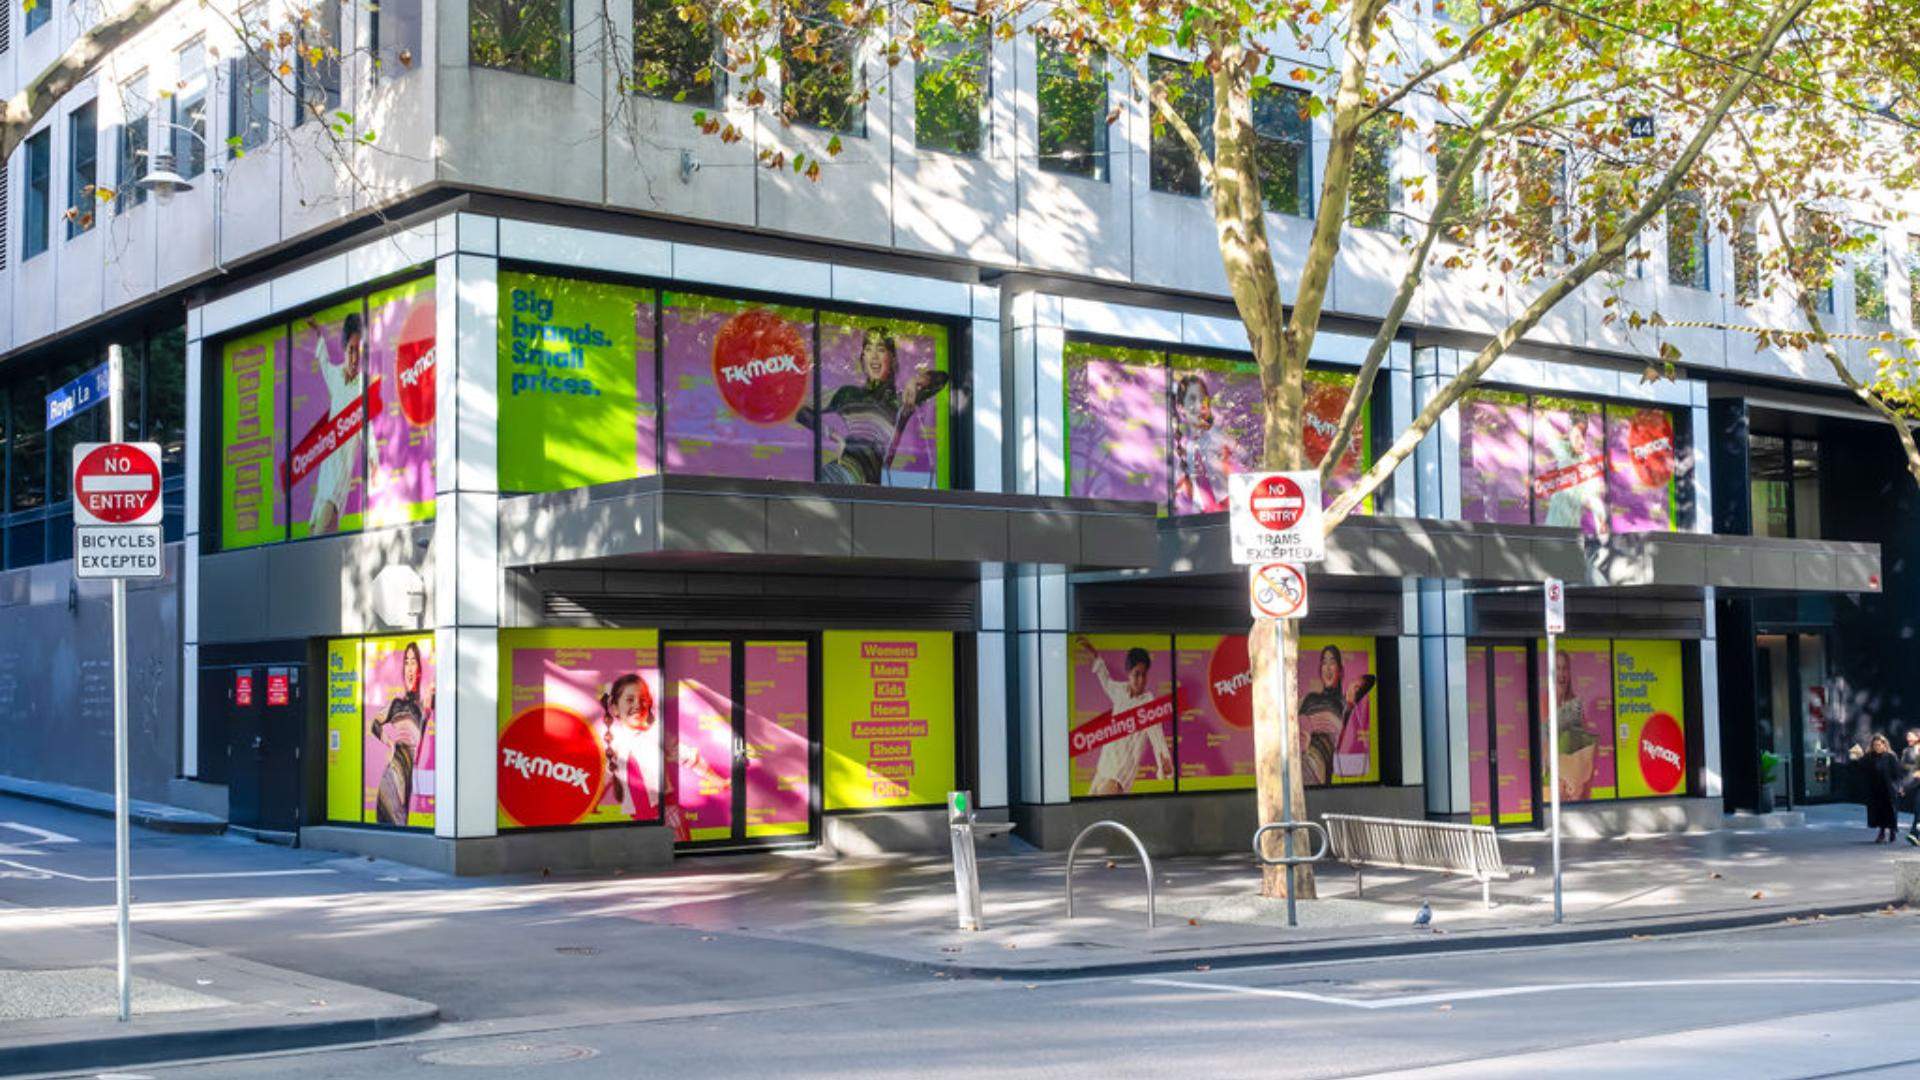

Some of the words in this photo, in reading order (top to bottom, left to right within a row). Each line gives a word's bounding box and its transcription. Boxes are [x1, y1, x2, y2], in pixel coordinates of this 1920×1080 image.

[1632, 121, 1652, 136] 44
[511, 290, 554, 321] Big
[511, 316, 612, 347] brands.
[511, 340, 585, 369] Small
[511, 369, 601, 396] prices.
[78, 385, 91, 404] La
[291, 429, 336, 474] Opening
[104, 457, 131, 472] NO
[1268, 484, 1286, 495] NO
[89, 493, 148, 509] ENTRY
[1259, 511, 1298, 522] ENTRY
[81, 534, 156, 548] BICYCLES
[1256, 533, 1301, 545] TRAMS
[1246, 548, 1313, 560] EXCEPTED
[81, 556, 156, 569] EXCEPTED
[1073, 715, 1136, 750] Opening
[1137, 701, 1173, 725] Soon
